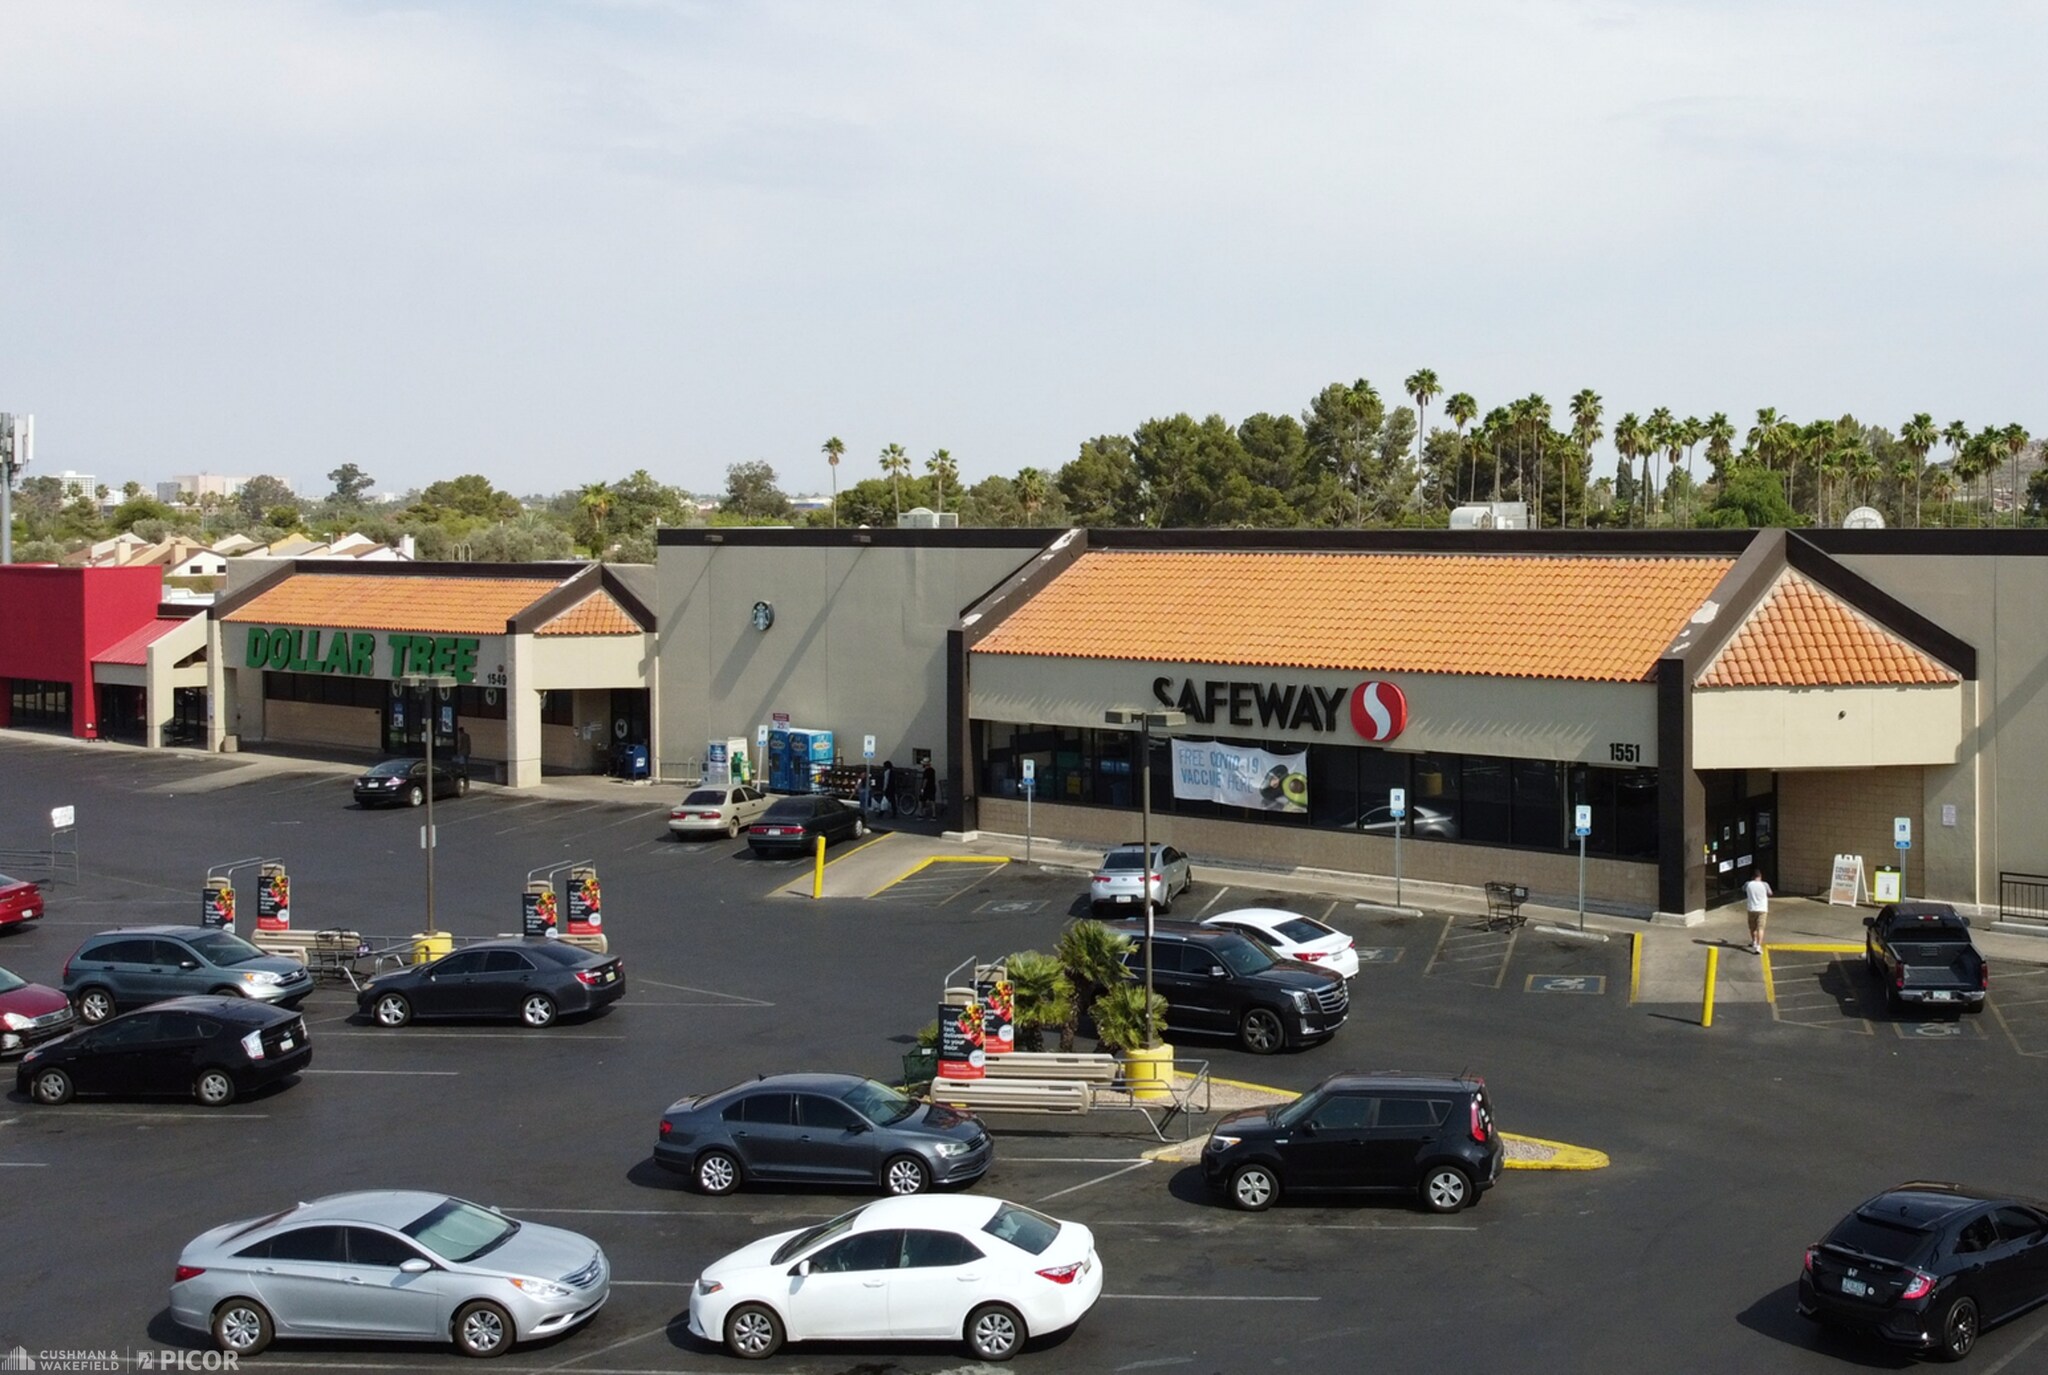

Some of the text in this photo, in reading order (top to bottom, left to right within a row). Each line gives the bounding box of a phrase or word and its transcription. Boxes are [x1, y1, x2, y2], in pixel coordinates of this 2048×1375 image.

[245, 627, 480, 684] DOLLAR TREE
[487, 673, 508, 686] 1549
[1152, 676, 1348, 732] SAFEWAY
[1179, 748, 1259, 774] FREE COVID-19
[1609, 742, 1640, 763] 1551
[1227, 772, 1254, 793] HERE
